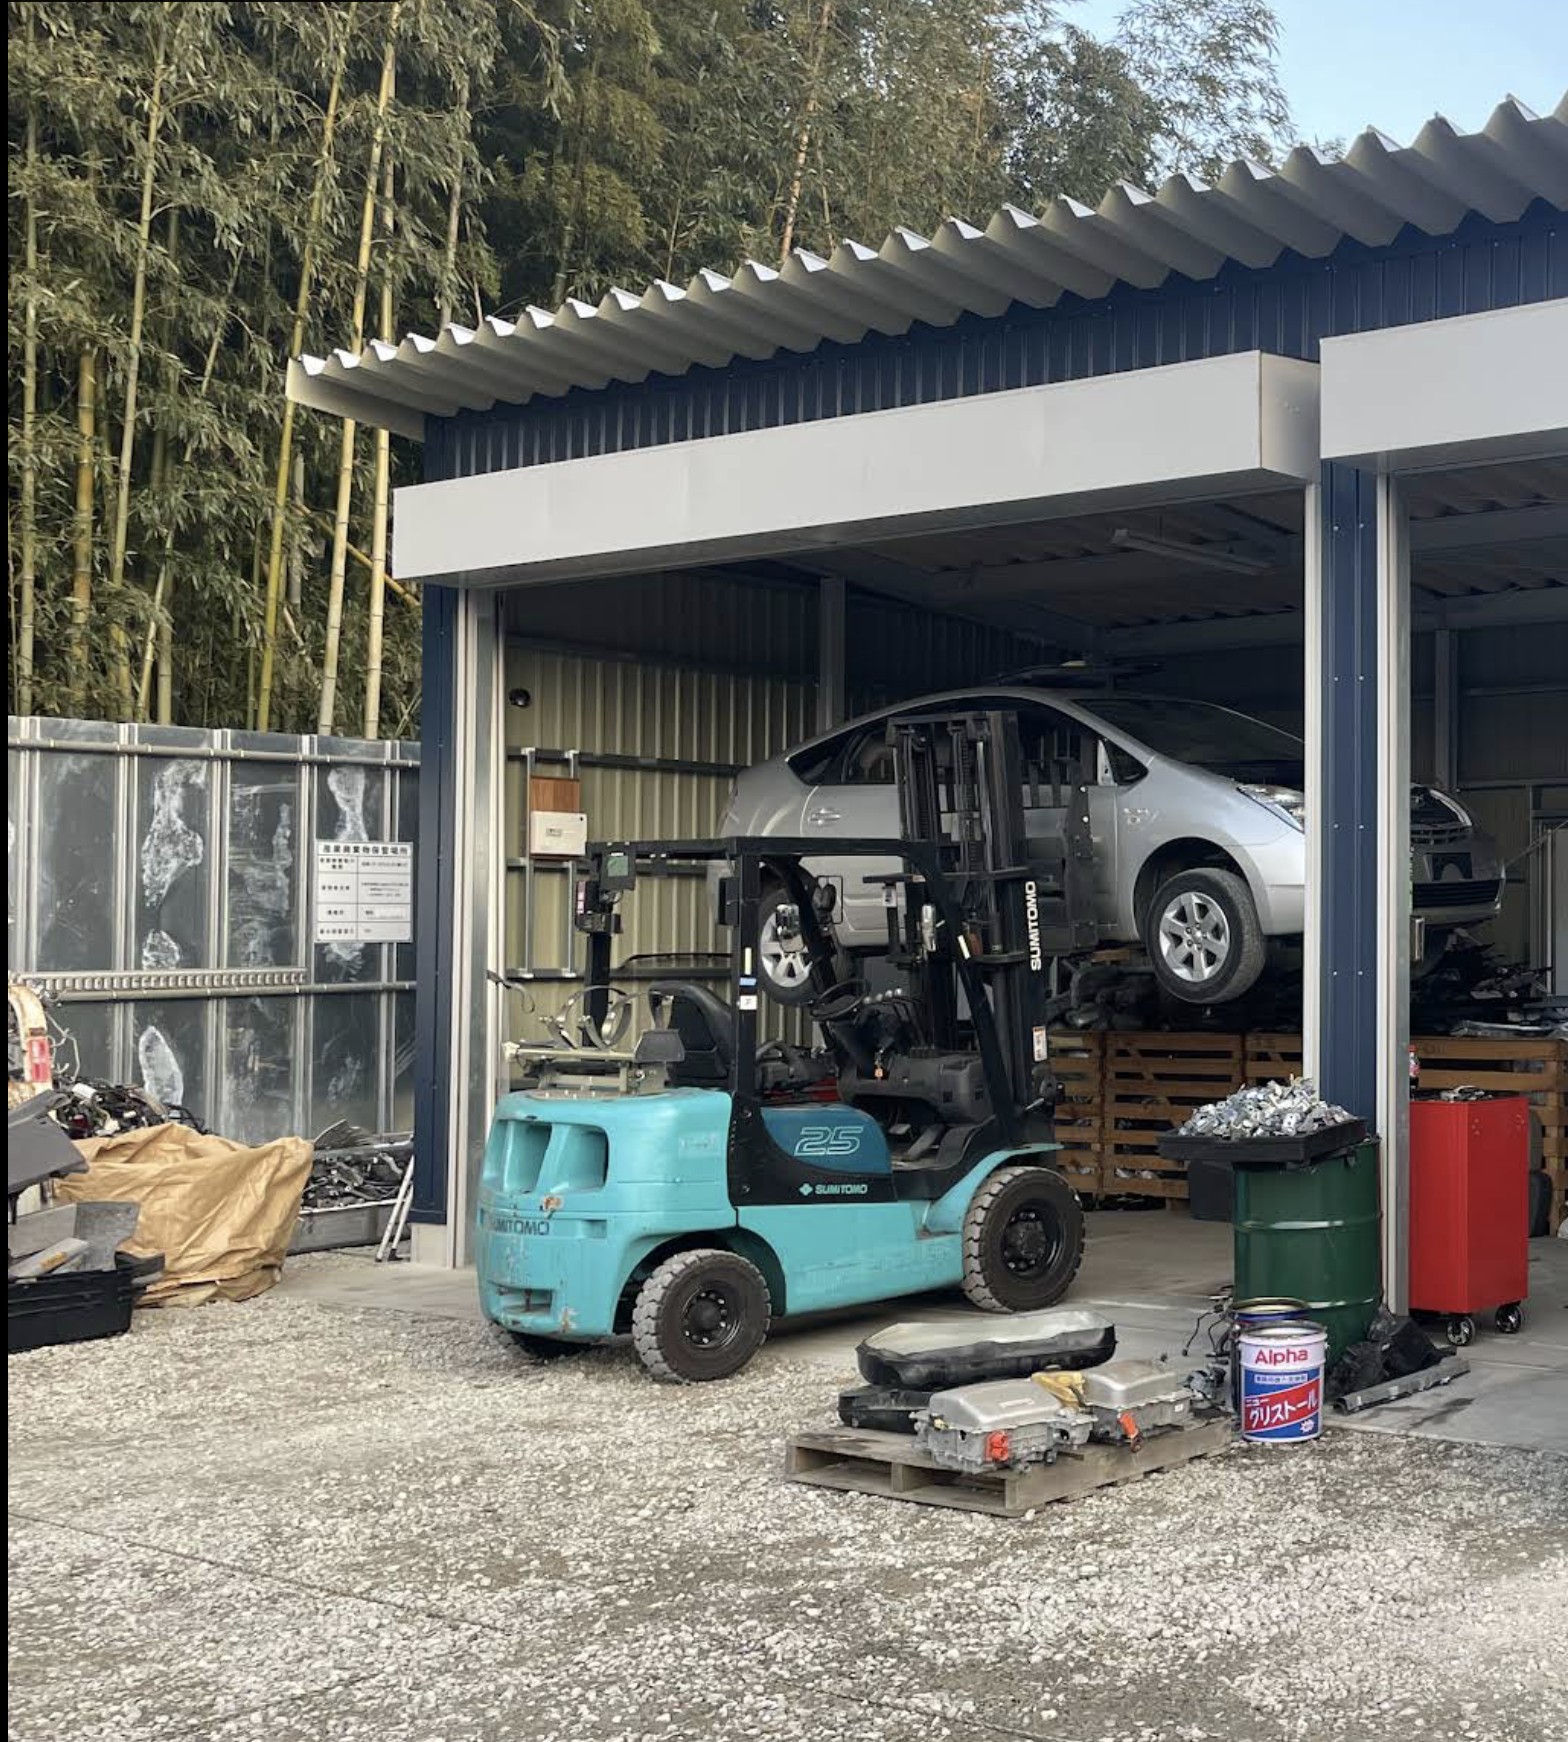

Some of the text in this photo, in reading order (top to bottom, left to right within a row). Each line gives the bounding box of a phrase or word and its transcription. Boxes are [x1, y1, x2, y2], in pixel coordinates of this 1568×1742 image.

[1025, 881, 1041, 971] SUMITOMO
[794, 1125, 864, 1156] 25
[815, 1184, 868, 1195] SUMITOMO
[1255, 1349, 1308, 1366] Alpha
